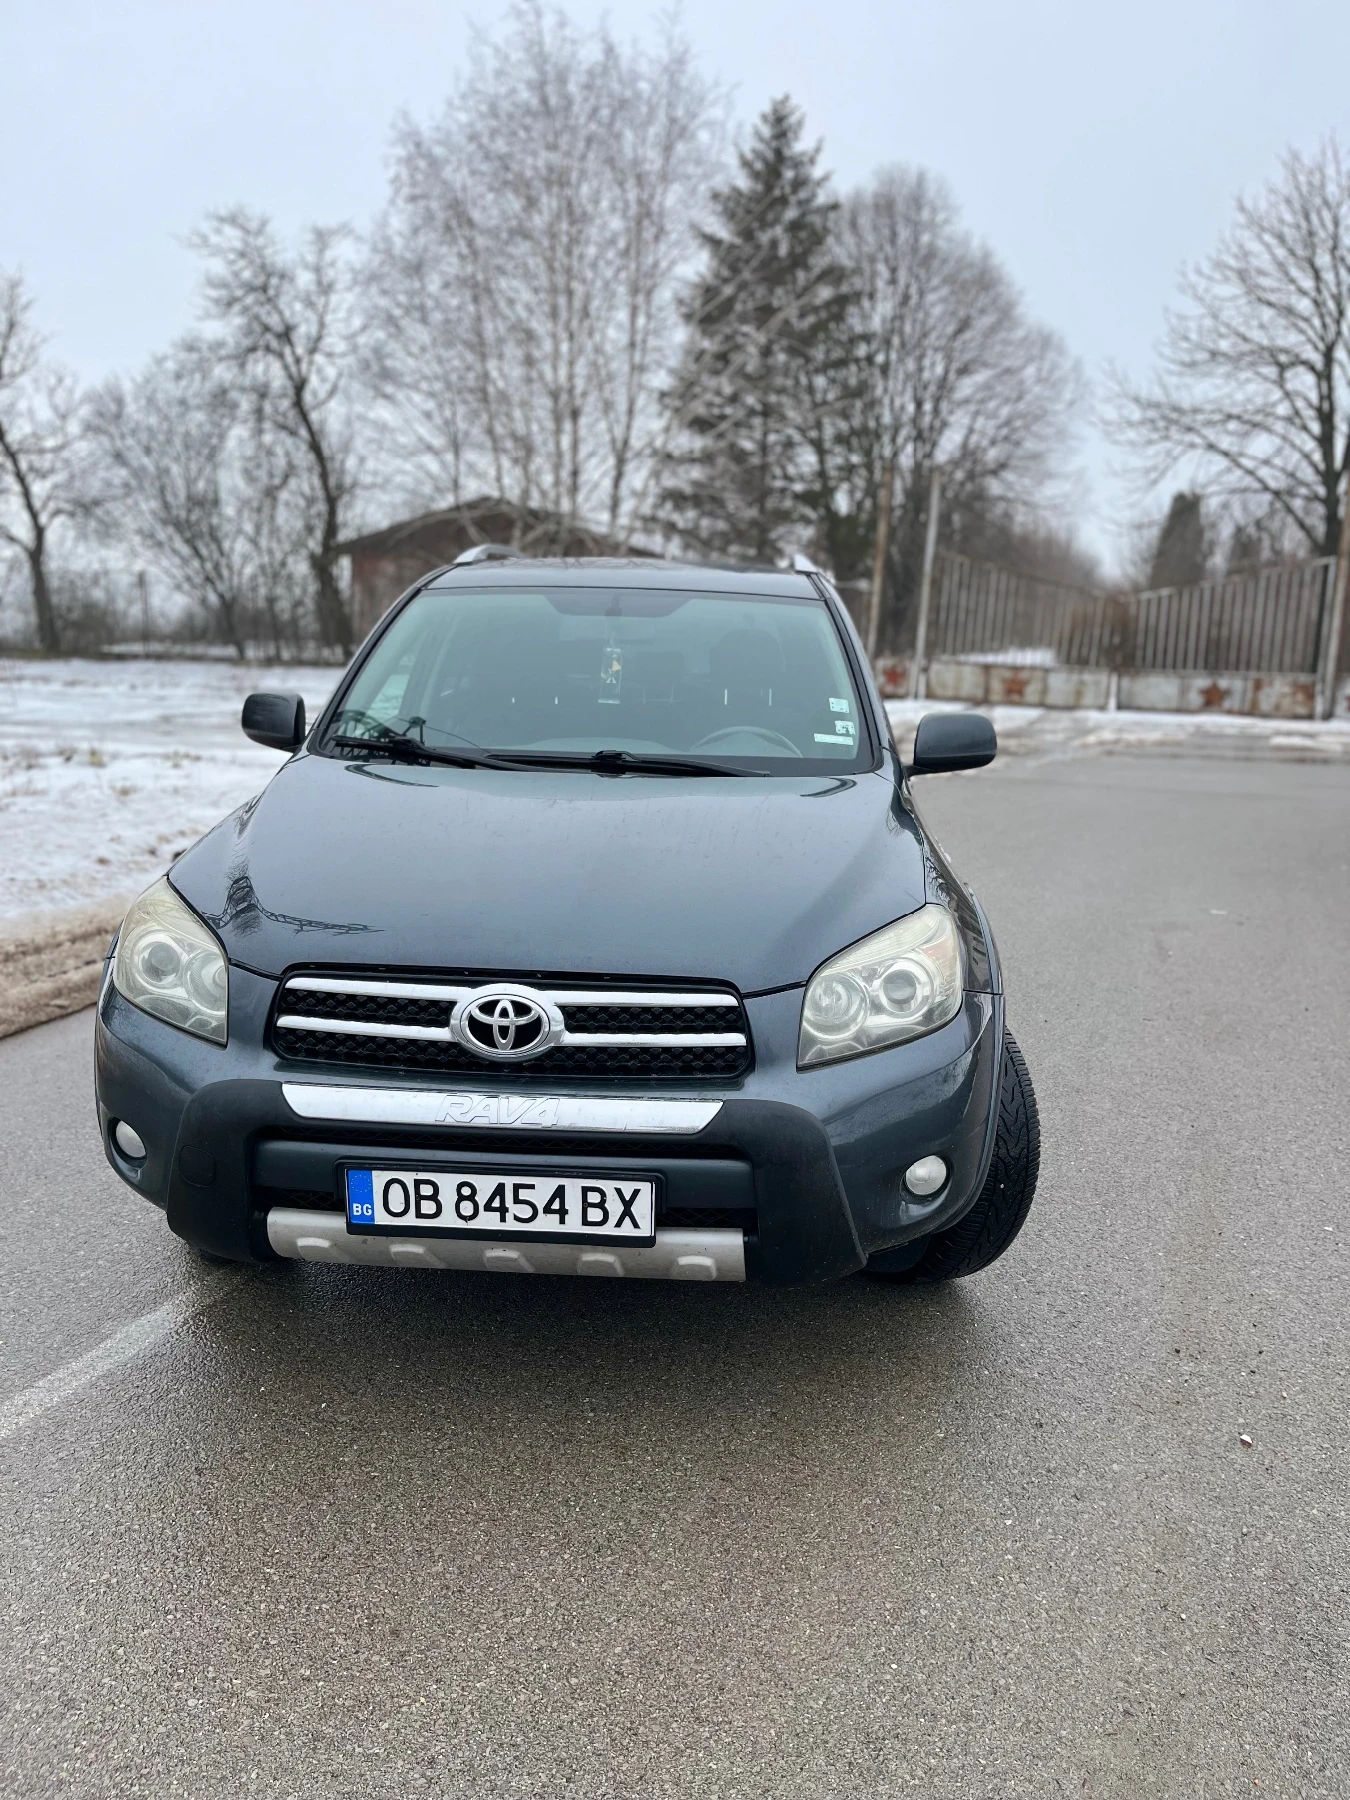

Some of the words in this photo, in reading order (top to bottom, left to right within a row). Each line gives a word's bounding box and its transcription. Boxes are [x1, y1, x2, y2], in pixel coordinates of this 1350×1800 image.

[435, 1094, 560, 1128] RAV4
[352, 1202, 373, 1217] BG
[382, 1177, 443, 1219] OB
[454, 1180, 569, 1225] 8454
[580, 1184, 642, 1229] BX
